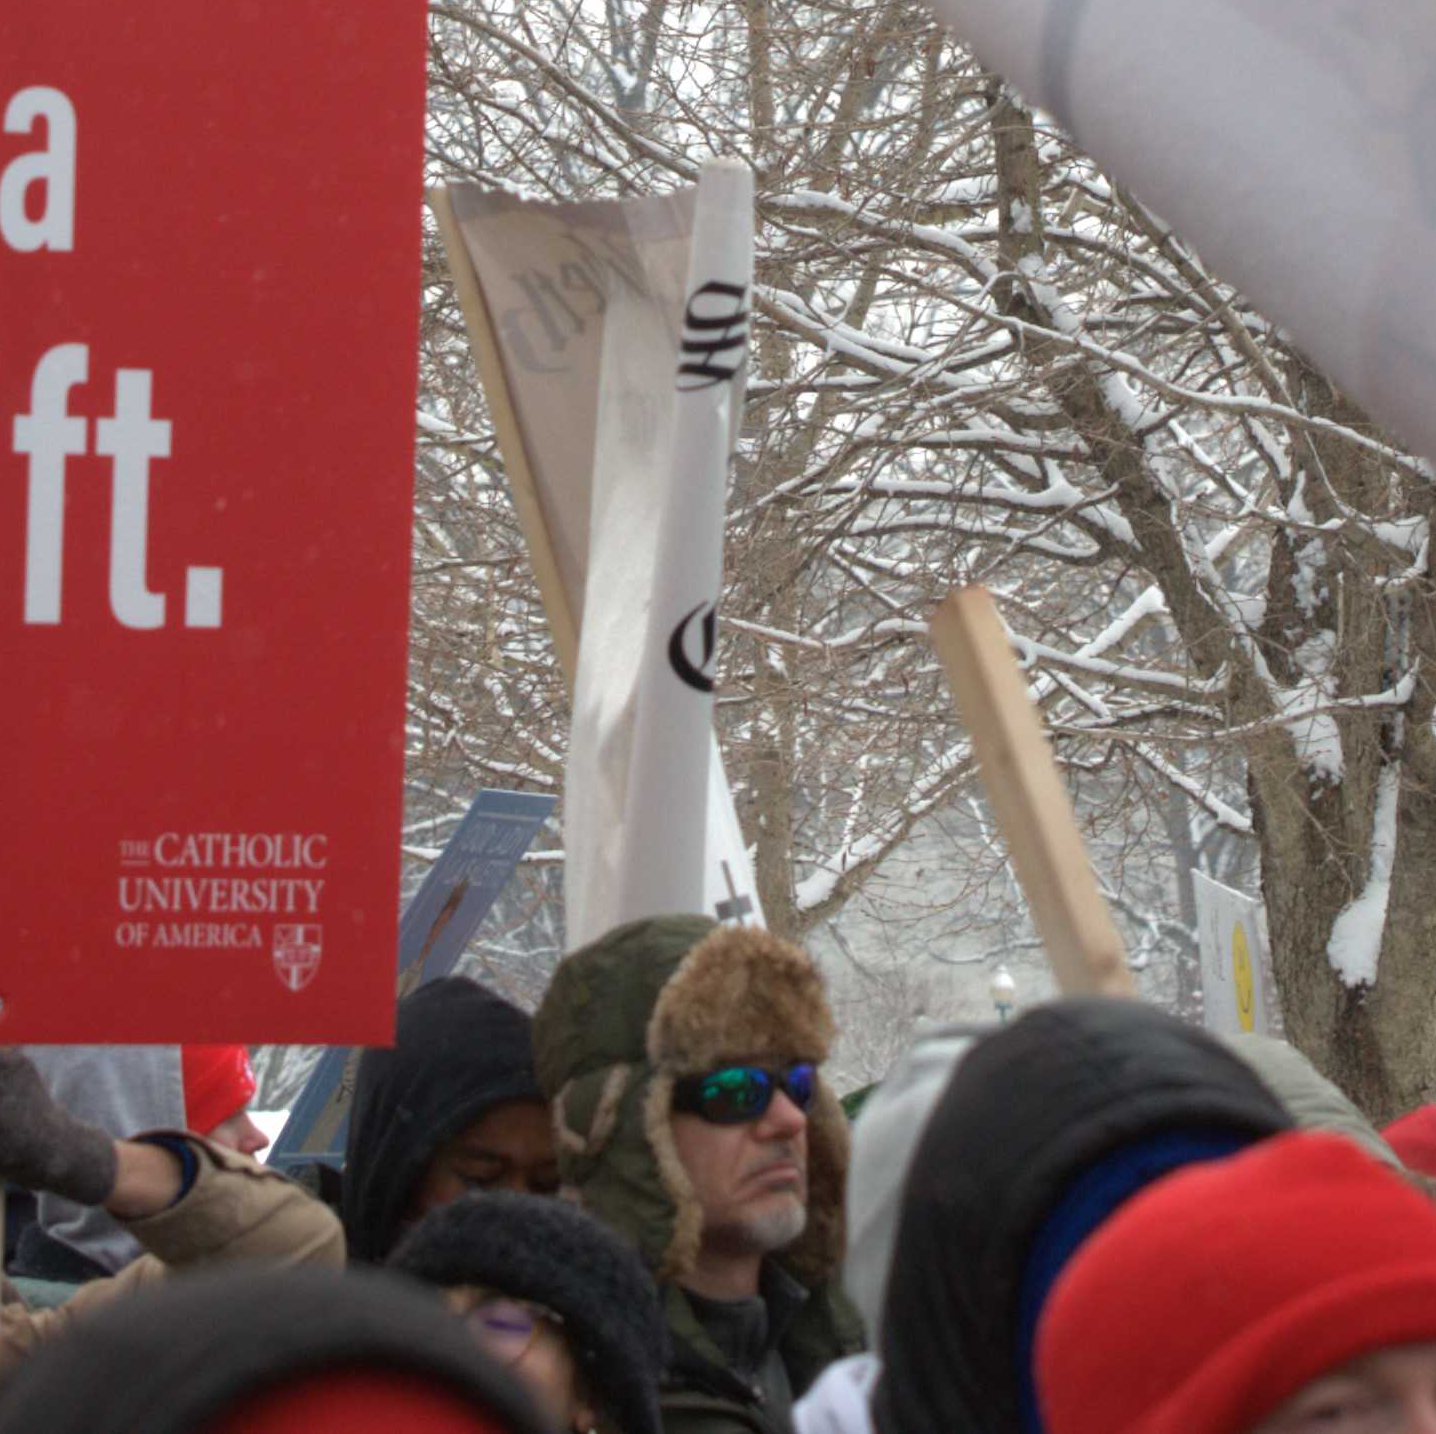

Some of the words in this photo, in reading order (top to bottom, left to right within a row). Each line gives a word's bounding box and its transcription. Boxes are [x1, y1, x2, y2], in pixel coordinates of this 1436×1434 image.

[118, 839, 149, 858] THE
[154, 831, 328, 869] CATHOLIC
[118, 877, 325, 913] UNIVERSITY
[115, 922, 148, 948] OF
[152, 922, 263, 948] AMERICA
